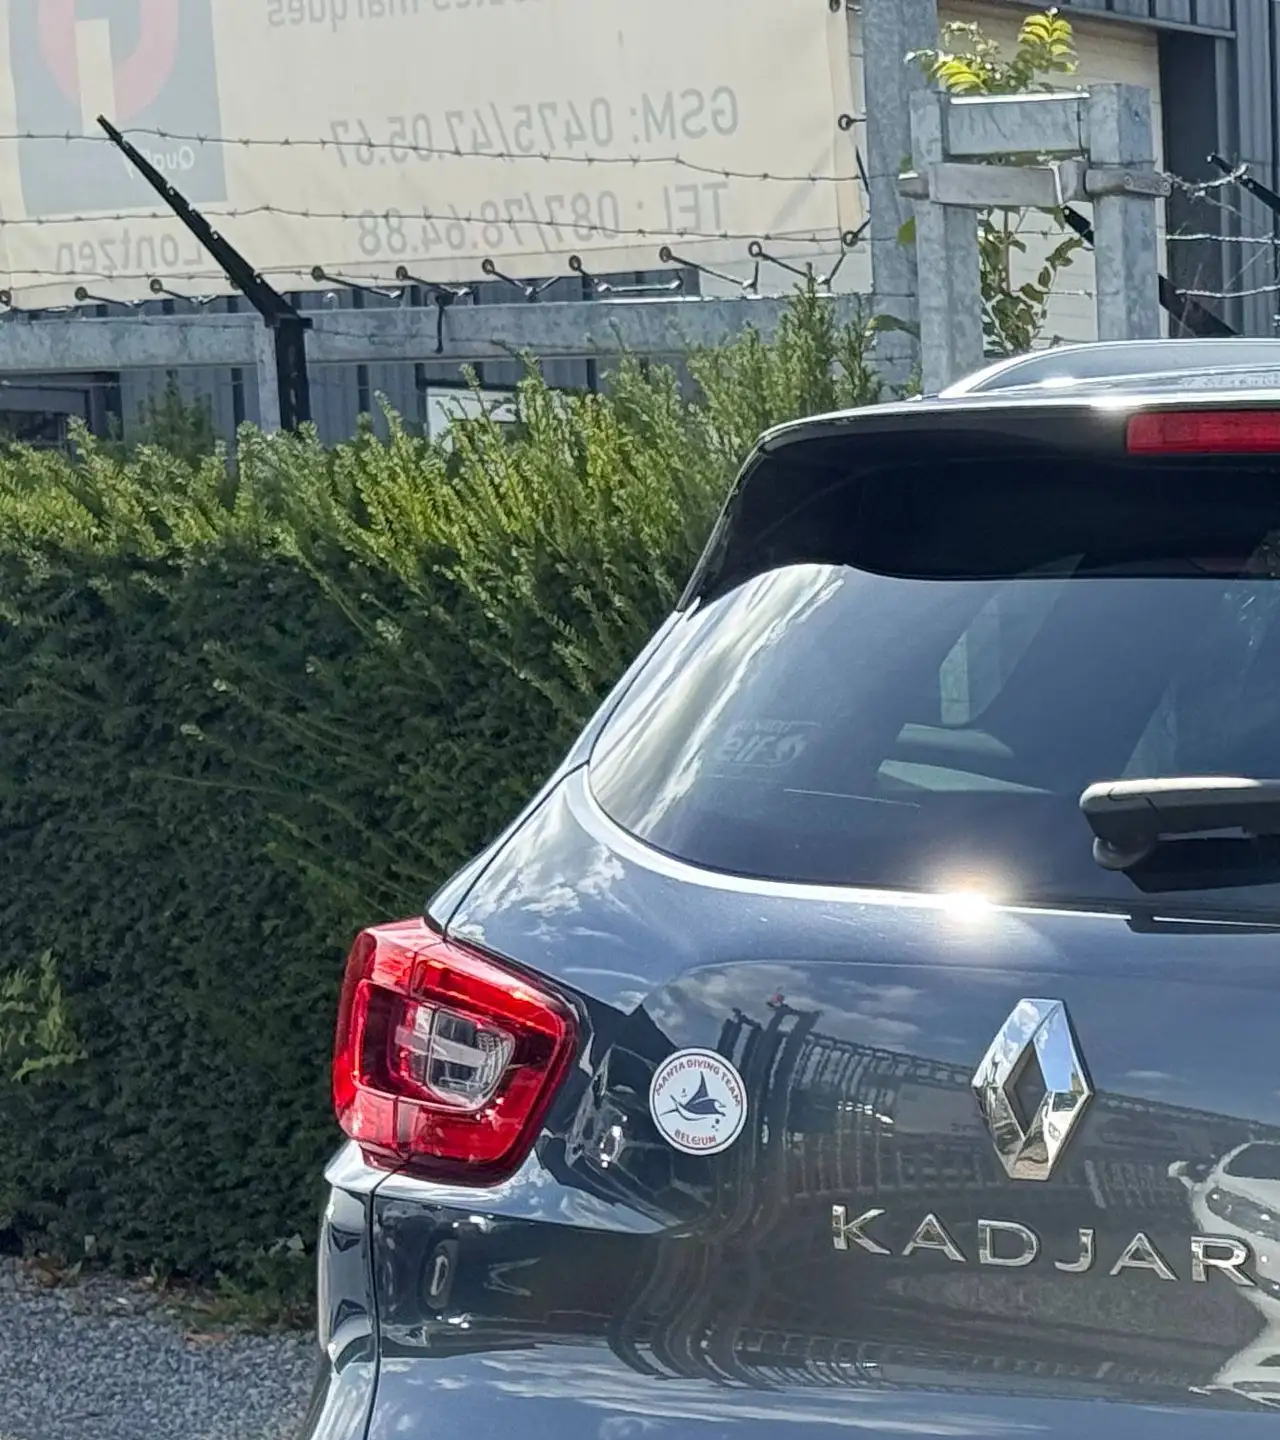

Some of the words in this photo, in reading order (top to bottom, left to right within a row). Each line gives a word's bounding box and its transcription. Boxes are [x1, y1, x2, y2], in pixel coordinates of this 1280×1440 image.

[655, 1061, 686, 1097] MANTA
[686, 1058, 720, 1075] DIVING
[721, 1071, 741, 1107] TEAM
[674, 1127, 717, 1146] BELGIUM
[831, 1203, 1257, 1287] KADJAR
